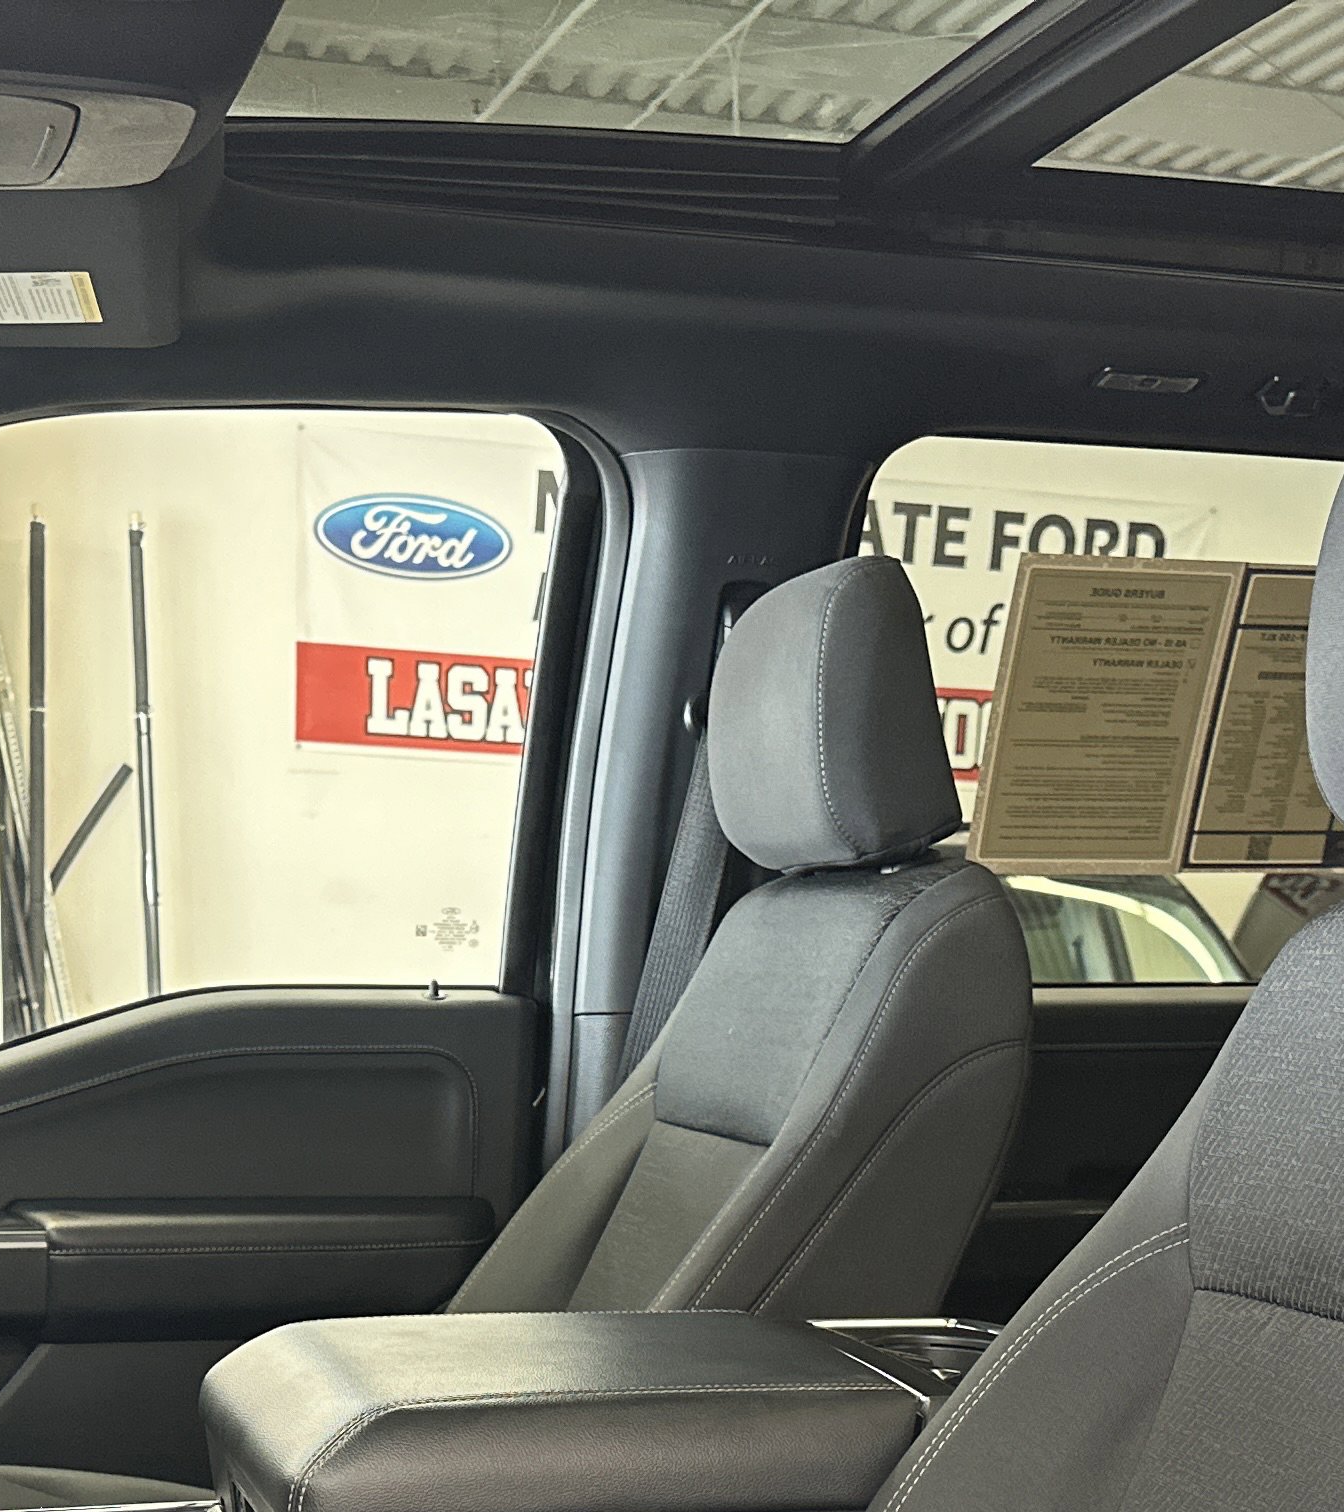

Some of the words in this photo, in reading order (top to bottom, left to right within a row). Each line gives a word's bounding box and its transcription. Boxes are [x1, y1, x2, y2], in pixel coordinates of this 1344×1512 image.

[351, 504, 479, 571] Ford
[946, 602, 1005, 655] of
[365, 656, 534, 744] LASA
